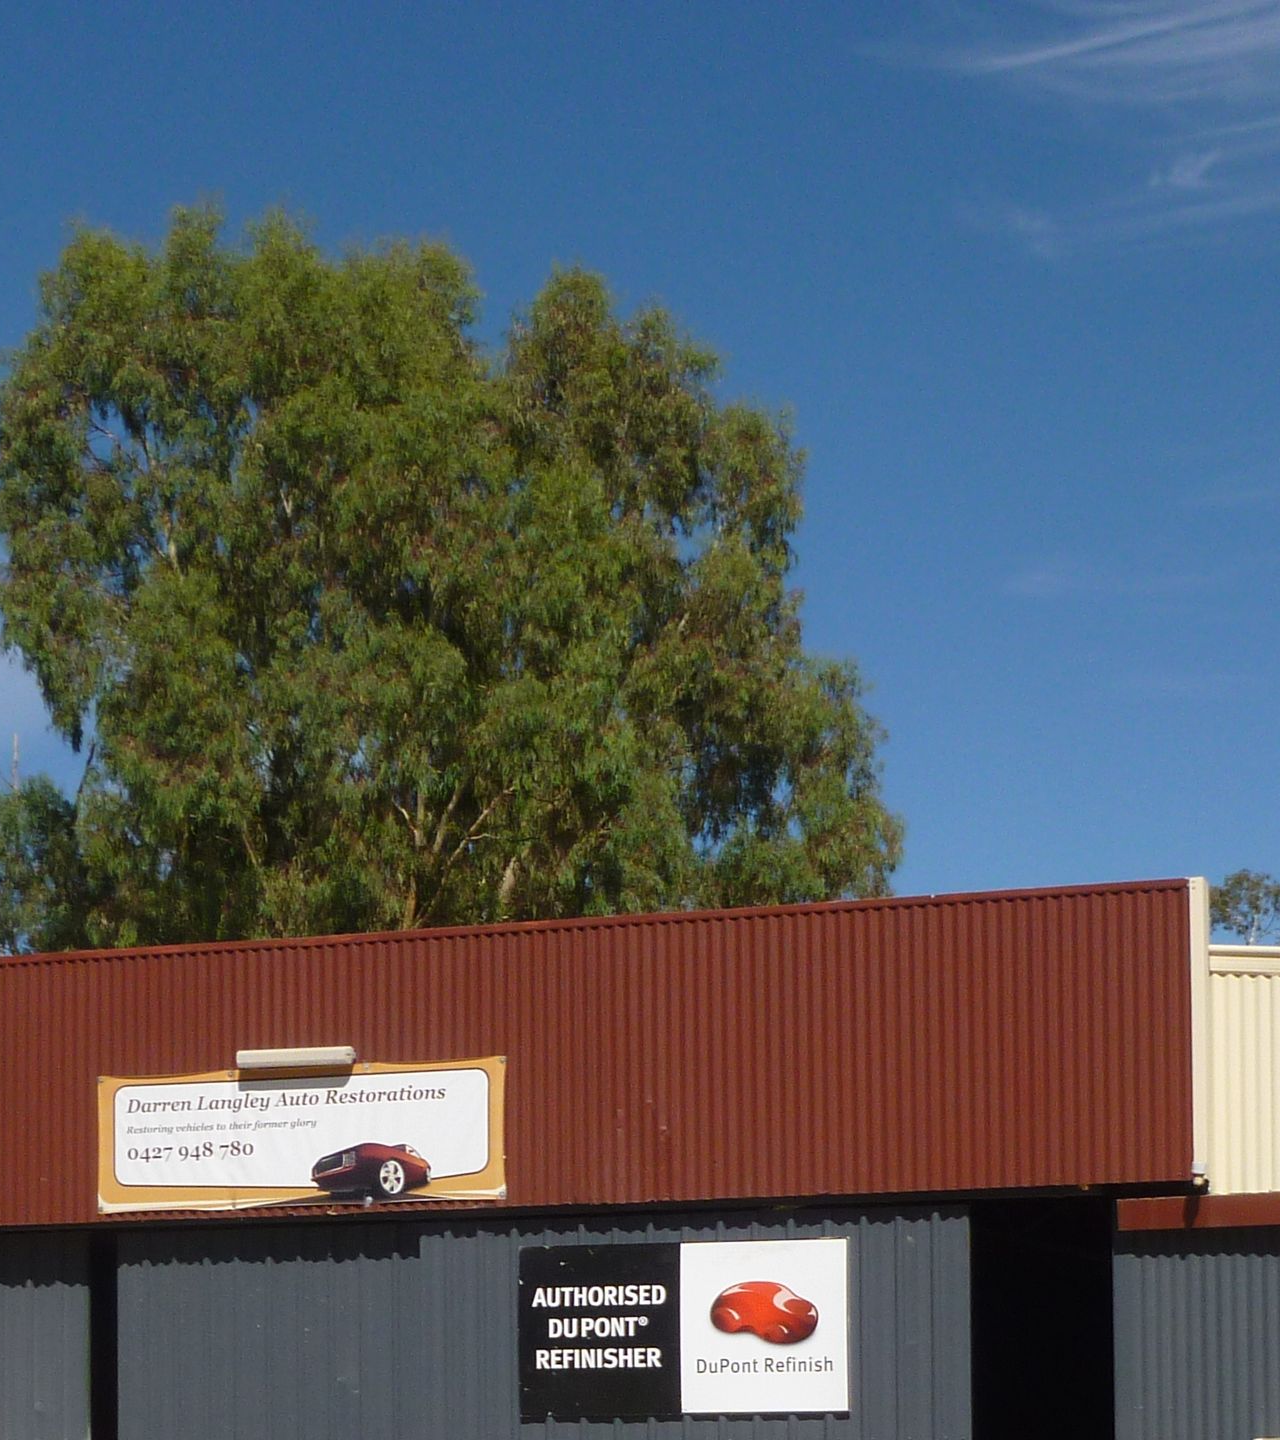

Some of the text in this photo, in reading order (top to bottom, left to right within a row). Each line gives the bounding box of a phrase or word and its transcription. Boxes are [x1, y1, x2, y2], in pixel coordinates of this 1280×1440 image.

[127, 1085, 446, 1113] Darren Langley Auto Restorations
[126, 1118, 317, 1136] Restoring vehicles to their former glory
[127, 1140, 254, 1163] 0427 948 780
[531, 1284, 667, 1308] AUTHORISED
[535, 1347, 662, 1370] REFINISHER
[696, 1356, 834, 1374] DuPont Refinish
